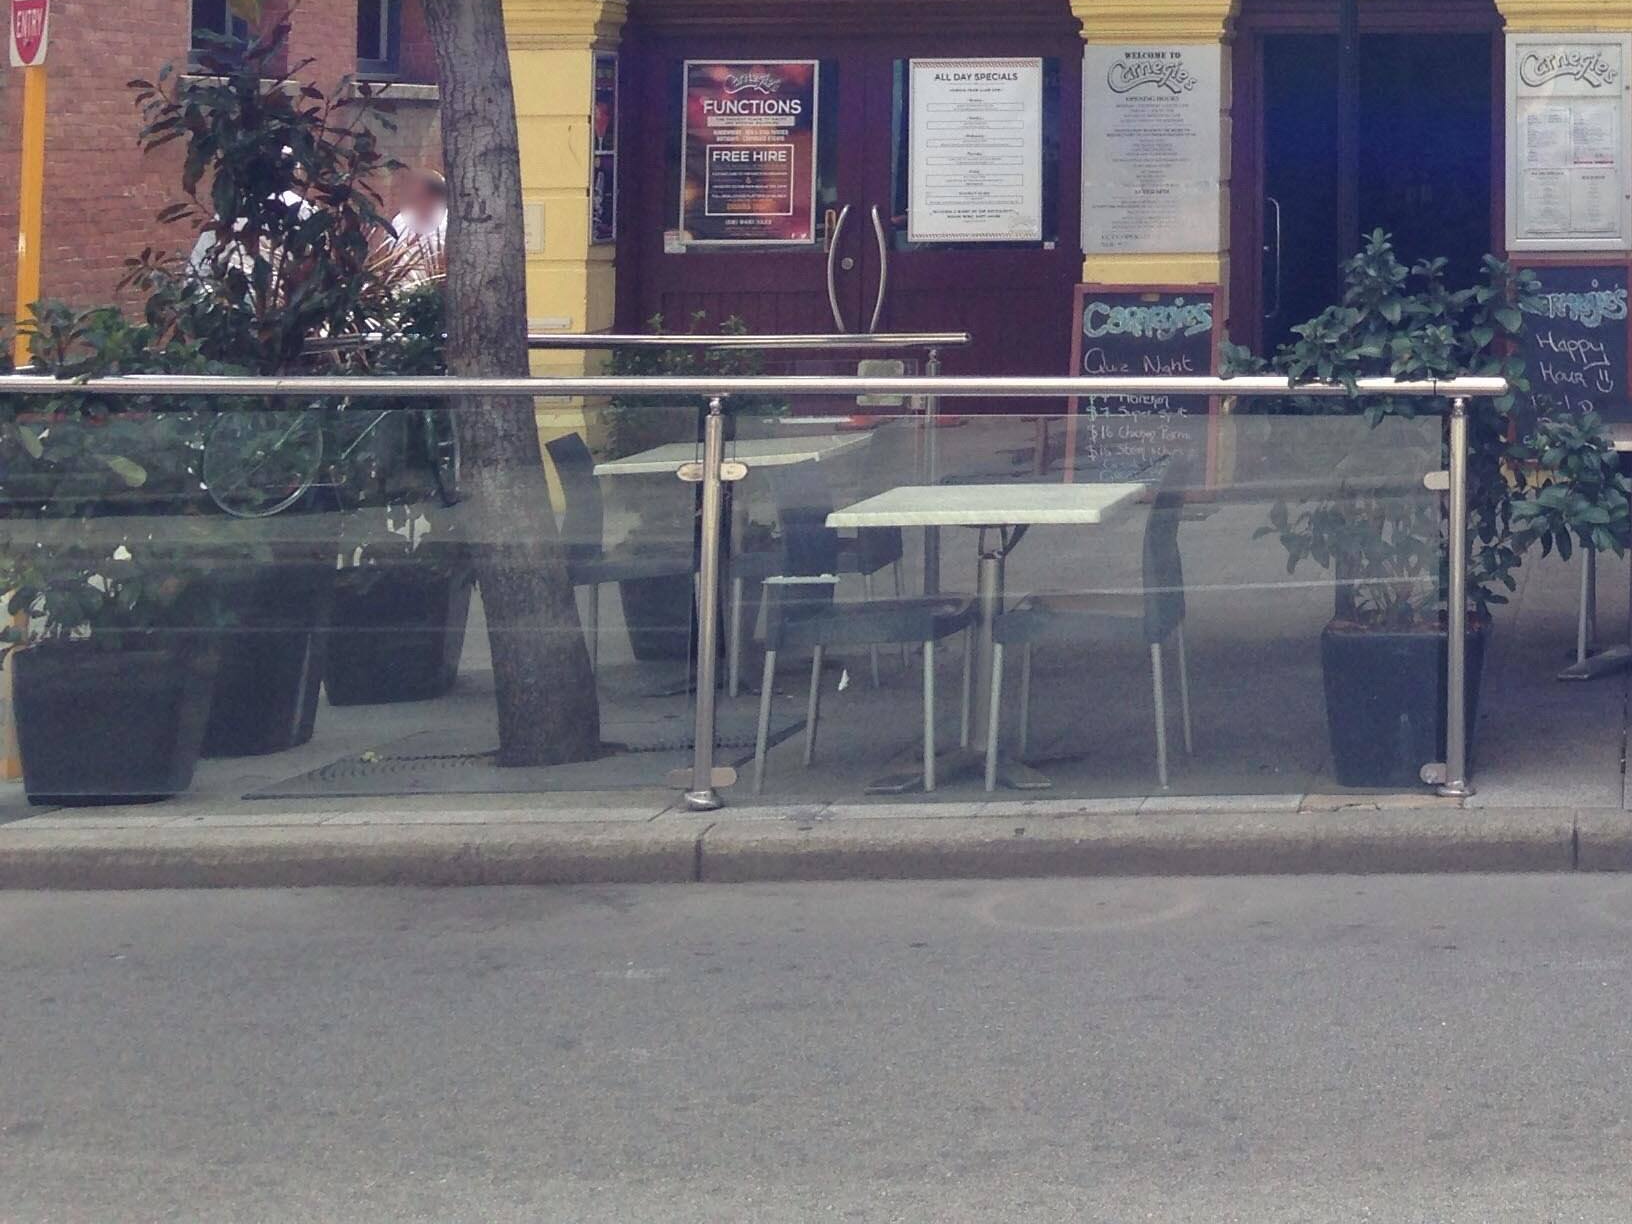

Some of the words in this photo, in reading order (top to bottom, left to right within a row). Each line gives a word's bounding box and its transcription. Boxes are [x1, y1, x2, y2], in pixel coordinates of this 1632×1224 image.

[16, 6, 43, 39] ENTRY
[1124, 51, 1167, 60] WELCOME
[1169, 51, 1181, 60] TO
[934, 72, 952, 82] ALL
[953, 72, 972, 82] DAY
[974, 72, 1018, 82] SPECIALS
[703, 99, 802, 114] FUNCTIONS
[712, 150, 750, 162] FREE
[752, 150, 787, 162] HIRE
[1536, 331, 1611, 371] Happy
[1539, 361, 1589, 388] Hour
